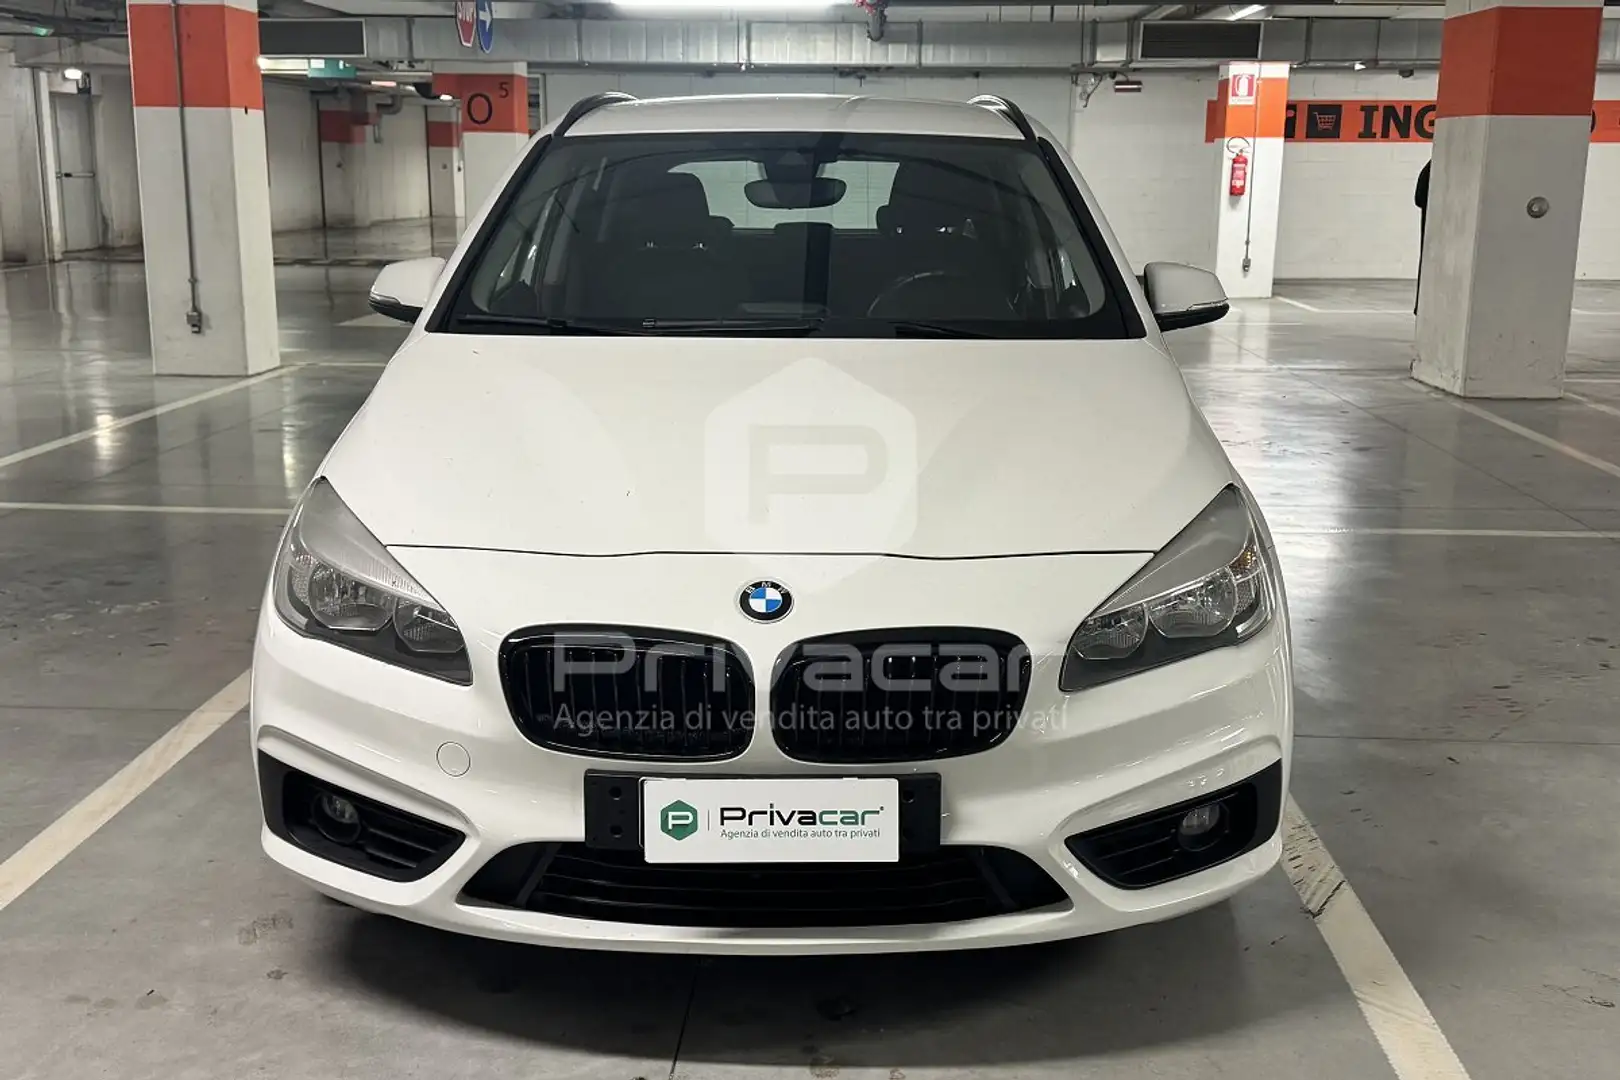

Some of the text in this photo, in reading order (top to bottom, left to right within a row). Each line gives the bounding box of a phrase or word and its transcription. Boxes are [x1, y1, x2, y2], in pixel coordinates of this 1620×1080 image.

[499, 82, 509, 98] 5
[720, 829, 880, 840] Agenzia di vendita auto tra privati
